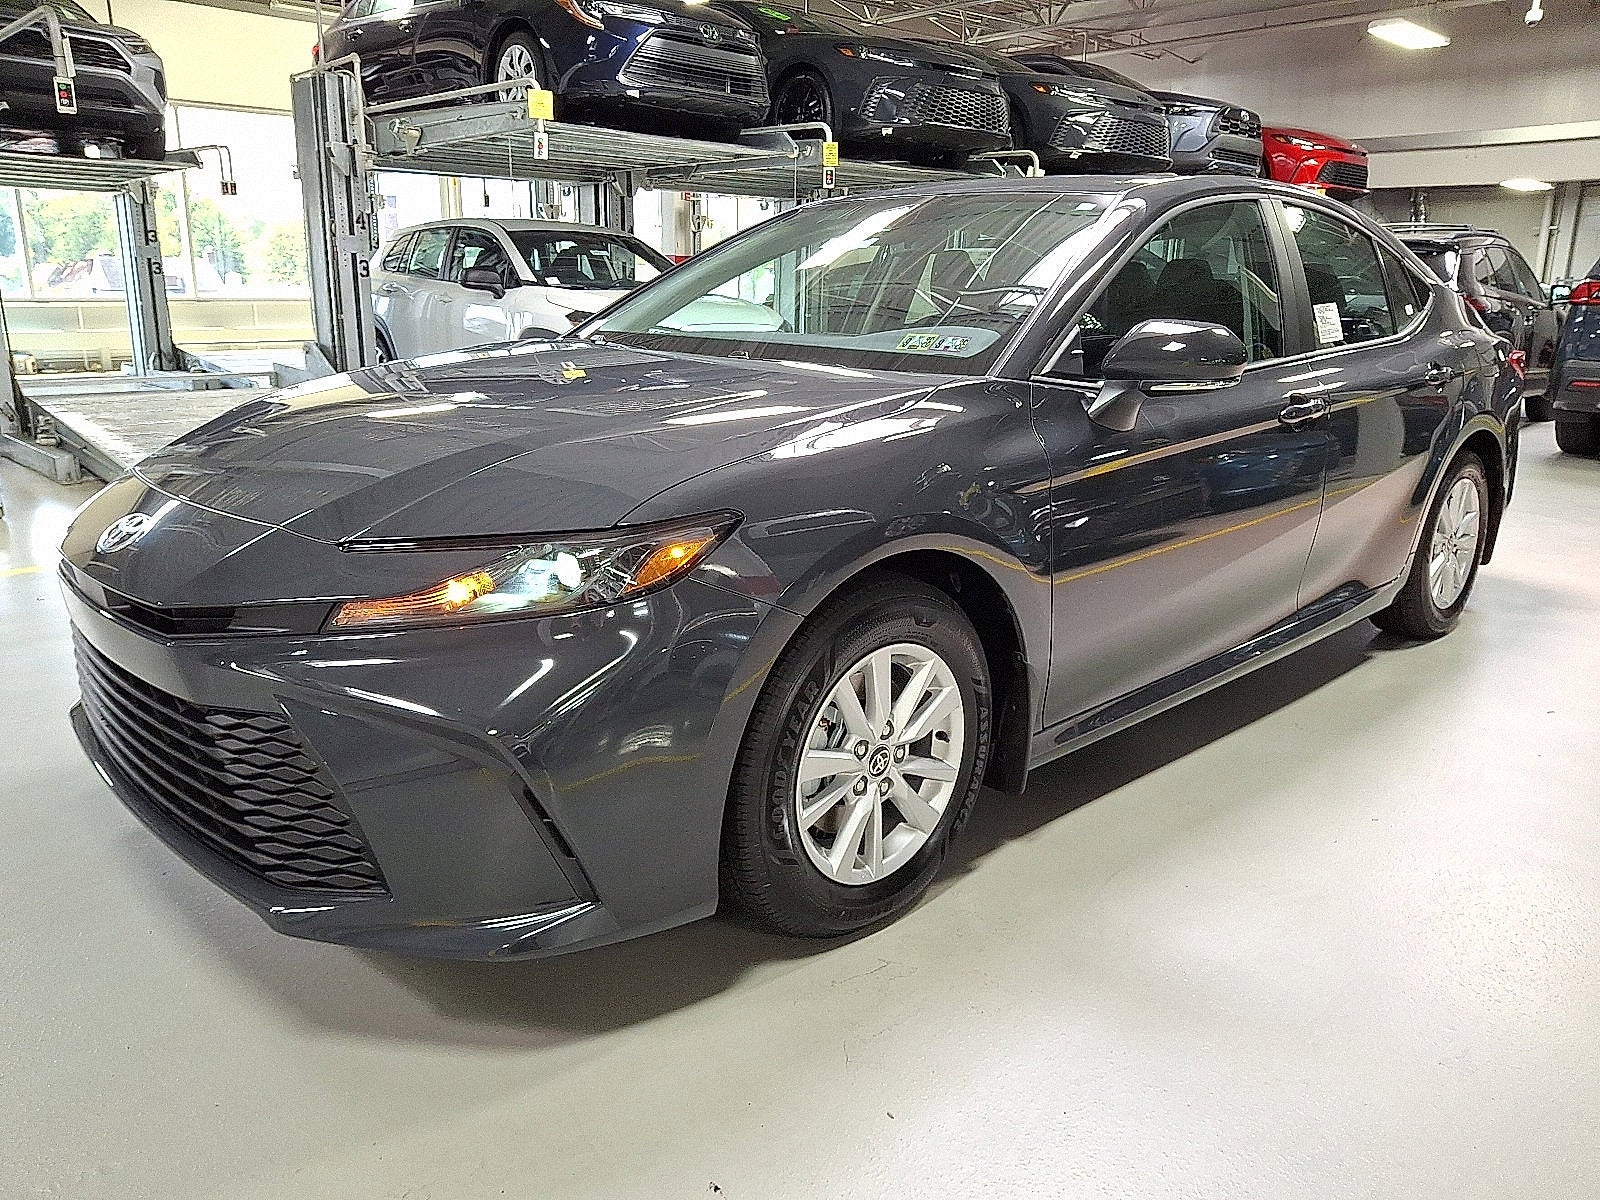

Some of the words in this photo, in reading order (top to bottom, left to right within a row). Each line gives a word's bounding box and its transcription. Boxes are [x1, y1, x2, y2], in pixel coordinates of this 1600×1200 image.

[356, 210, 366, 229] 4
[148, 229, 158, 243] 3
[153, 262, 162, 275] 3
[359, 260, 369, 277] 3
[772, 680, 820, 841] GOODYEAR
